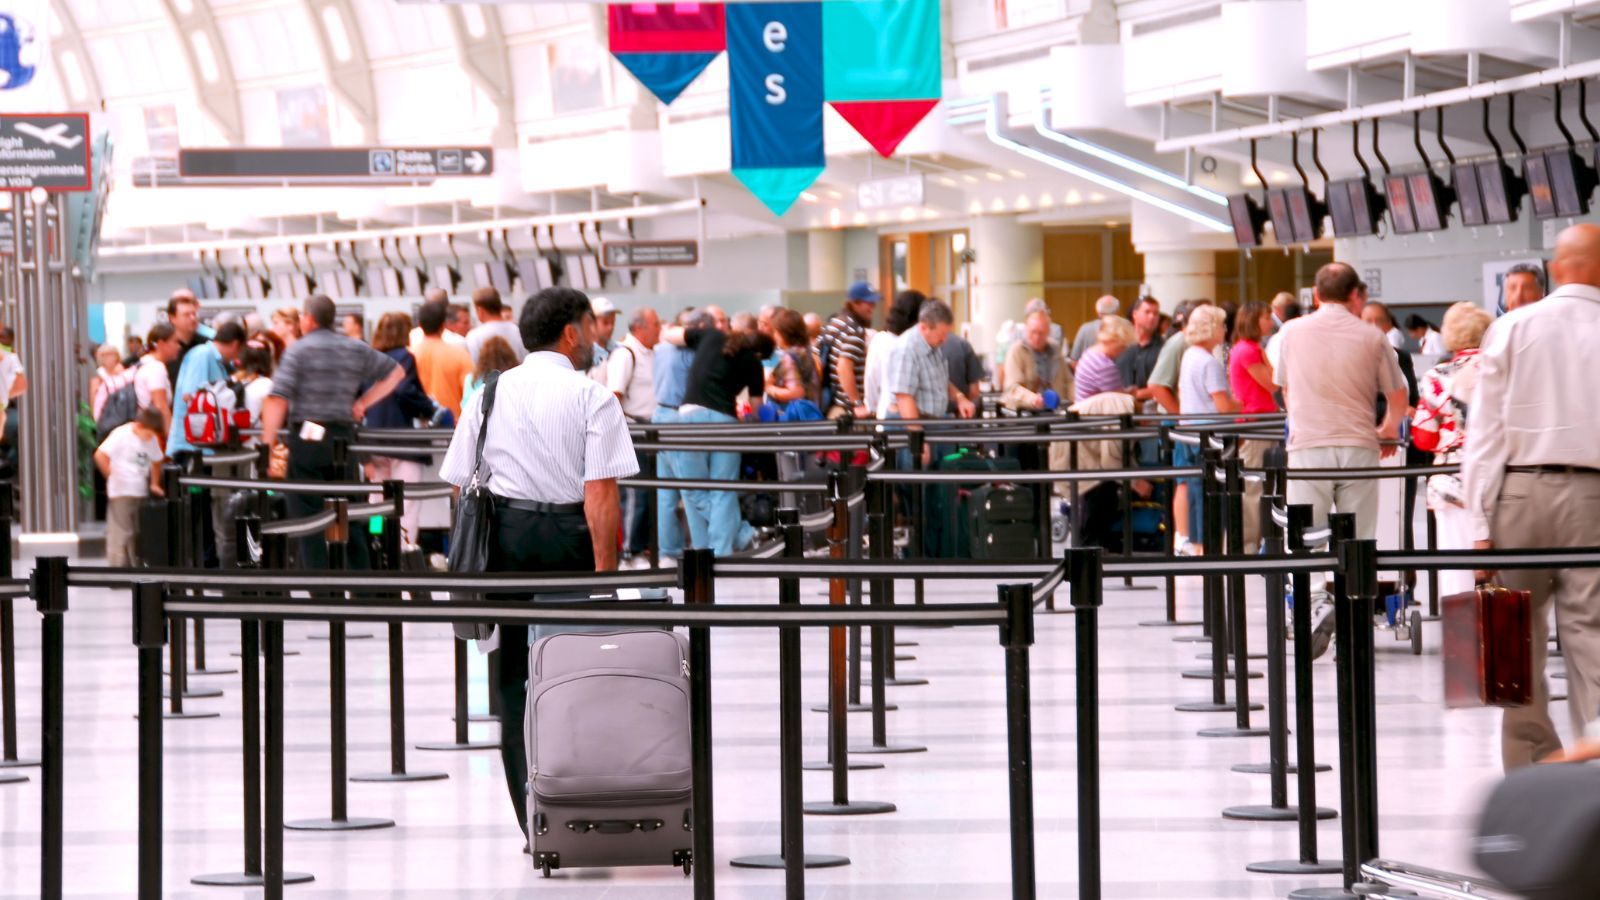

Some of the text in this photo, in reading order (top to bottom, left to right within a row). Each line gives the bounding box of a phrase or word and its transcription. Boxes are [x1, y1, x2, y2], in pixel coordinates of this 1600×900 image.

[0, 136, 23, 150] ight
[0, 148, 56, 160] formation
[8, 176, 33, 188] vols
